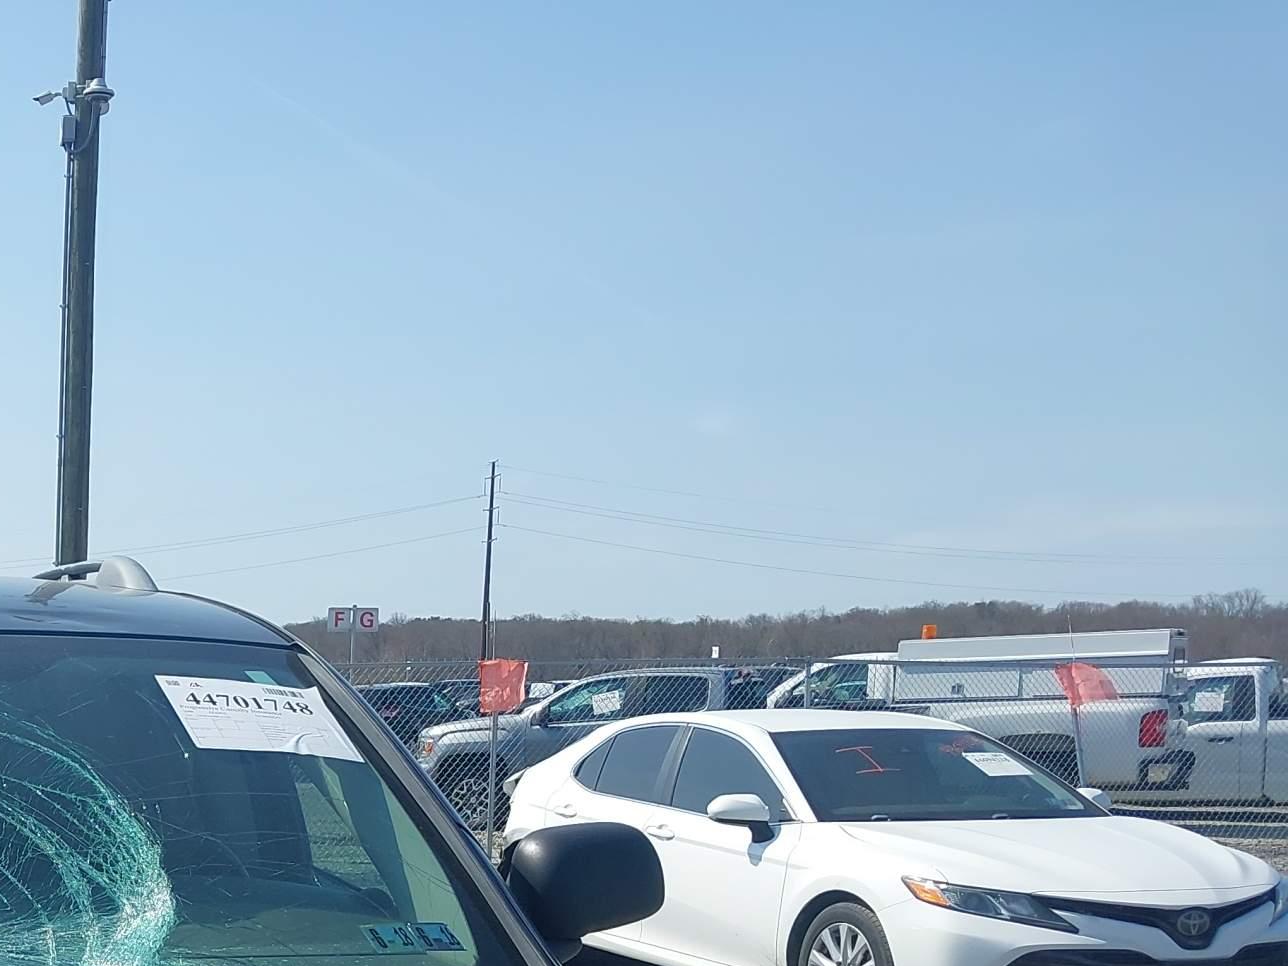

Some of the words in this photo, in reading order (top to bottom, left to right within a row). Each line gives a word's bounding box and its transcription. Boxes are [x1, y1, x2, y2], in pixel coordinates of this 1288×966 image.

[335, 612, 345, 627] F
[360, 612, 374, 627] G
[185, 691, 314, 716] 44701748
